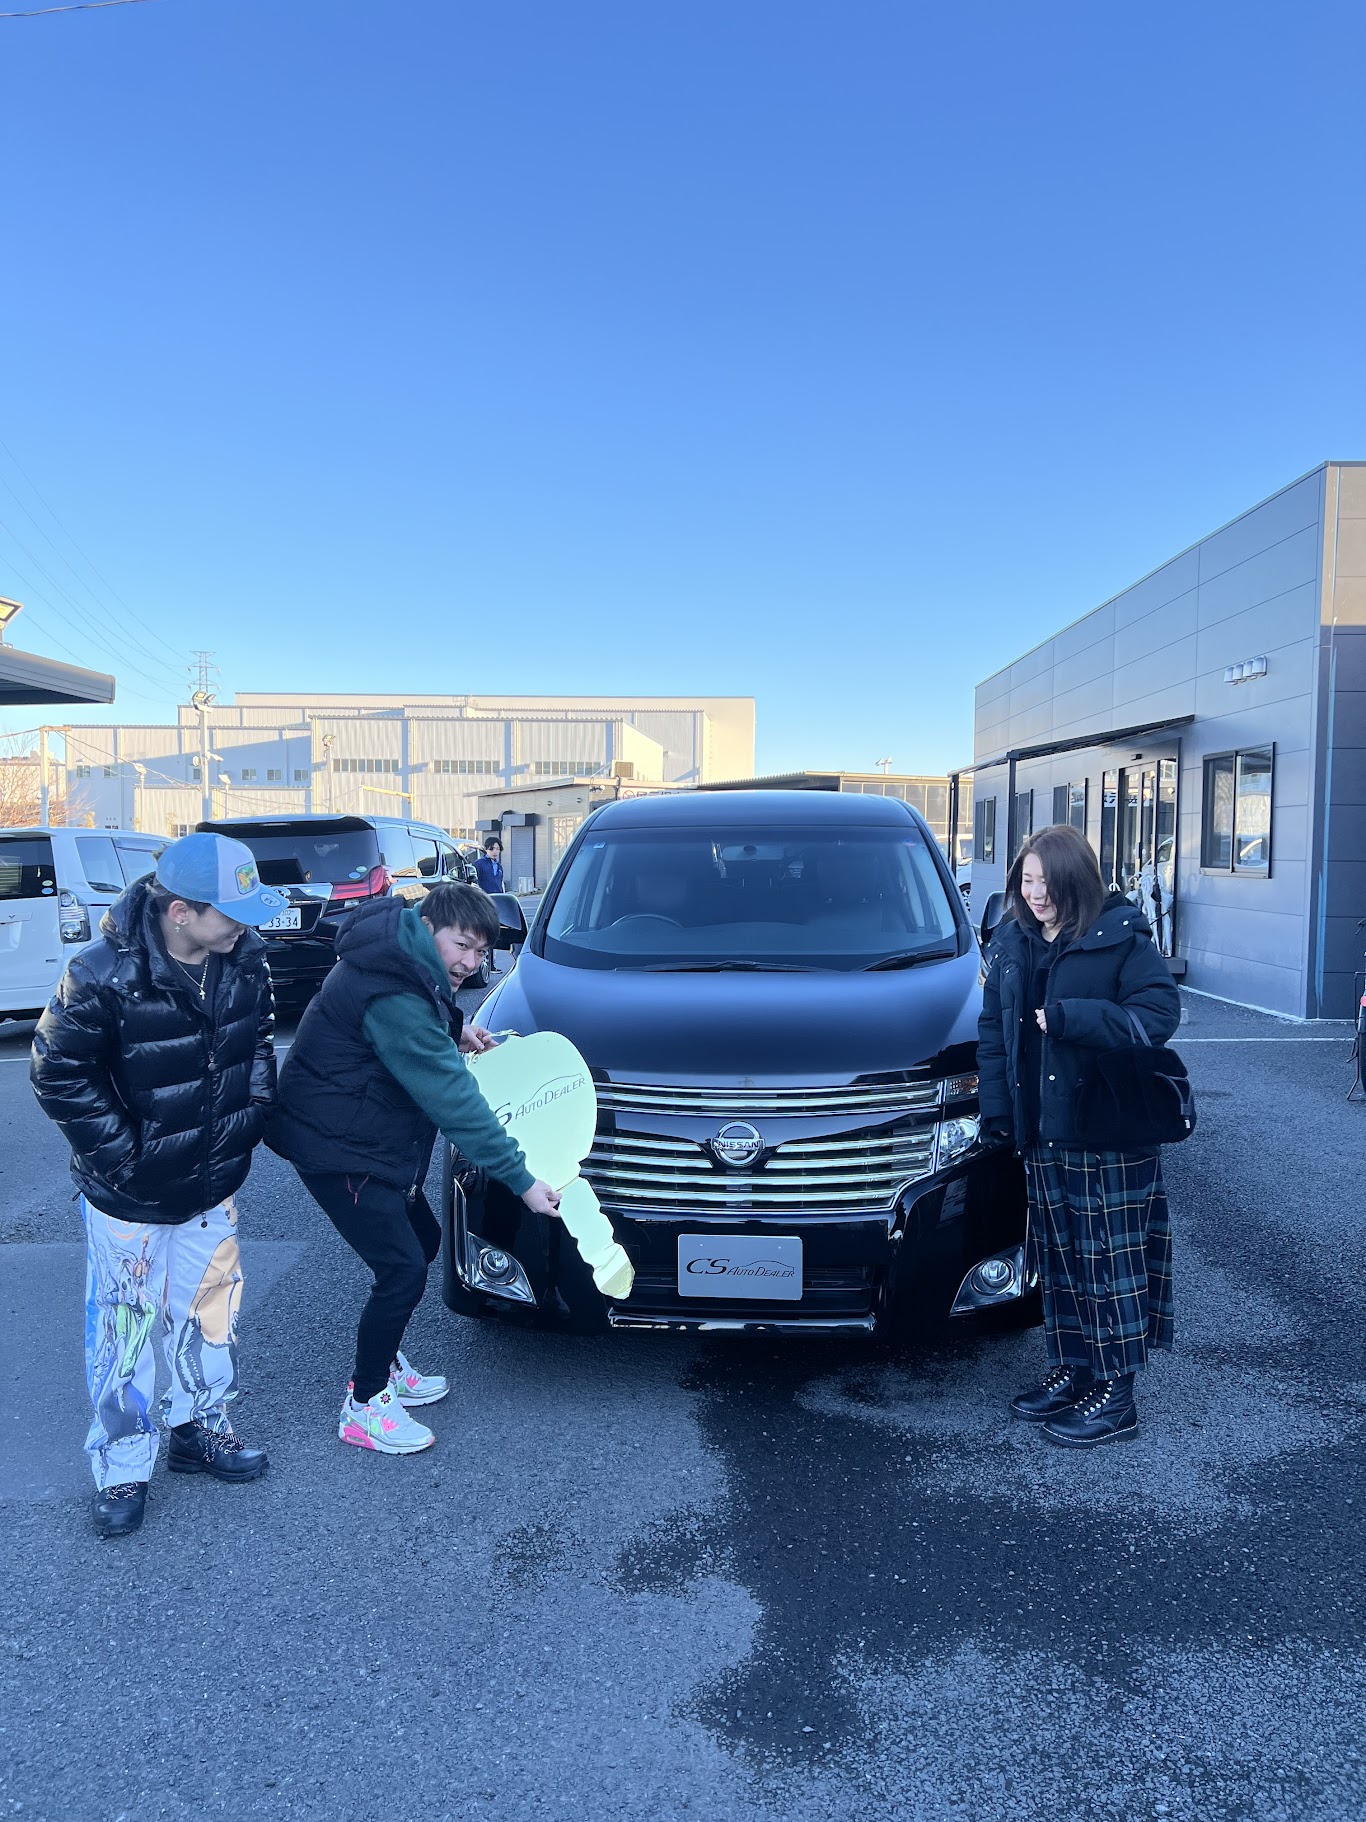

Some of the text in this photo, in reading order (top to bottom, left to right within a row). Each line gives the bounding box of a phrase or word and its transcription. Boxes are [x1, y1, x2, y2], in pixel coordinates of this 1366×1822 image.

[493, 1101, 512, 1127] S
[718, 1141, 760, 1149] NISSAN
[686, 1258, 731, 1275] CS
